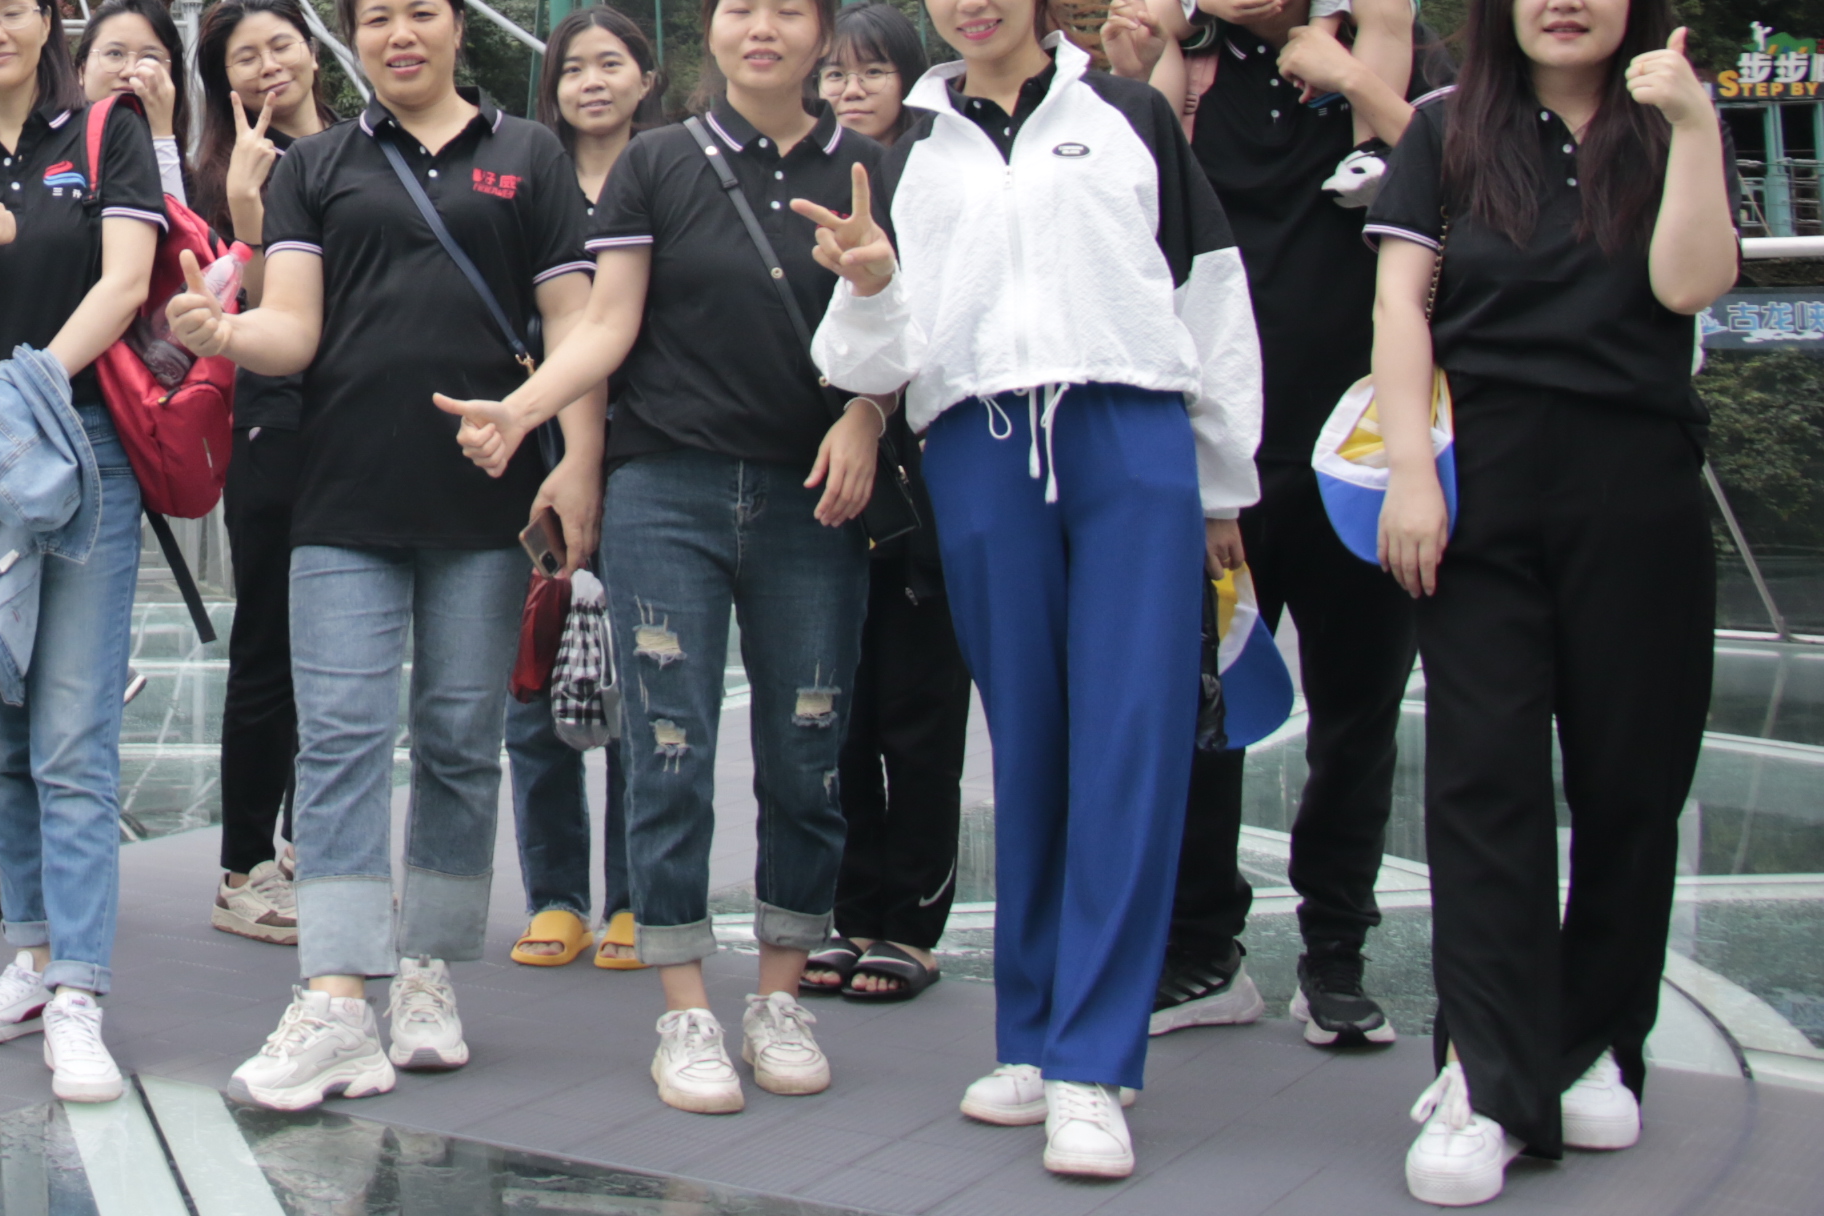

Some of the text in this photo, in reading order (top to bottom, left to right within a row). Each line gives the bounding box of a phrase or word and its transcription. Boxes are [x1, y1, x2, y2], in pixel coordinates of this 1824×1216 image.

[1717, 69, 1820, 97] STEP BY
[1727, 301, 1824, 333] 古龙峡
